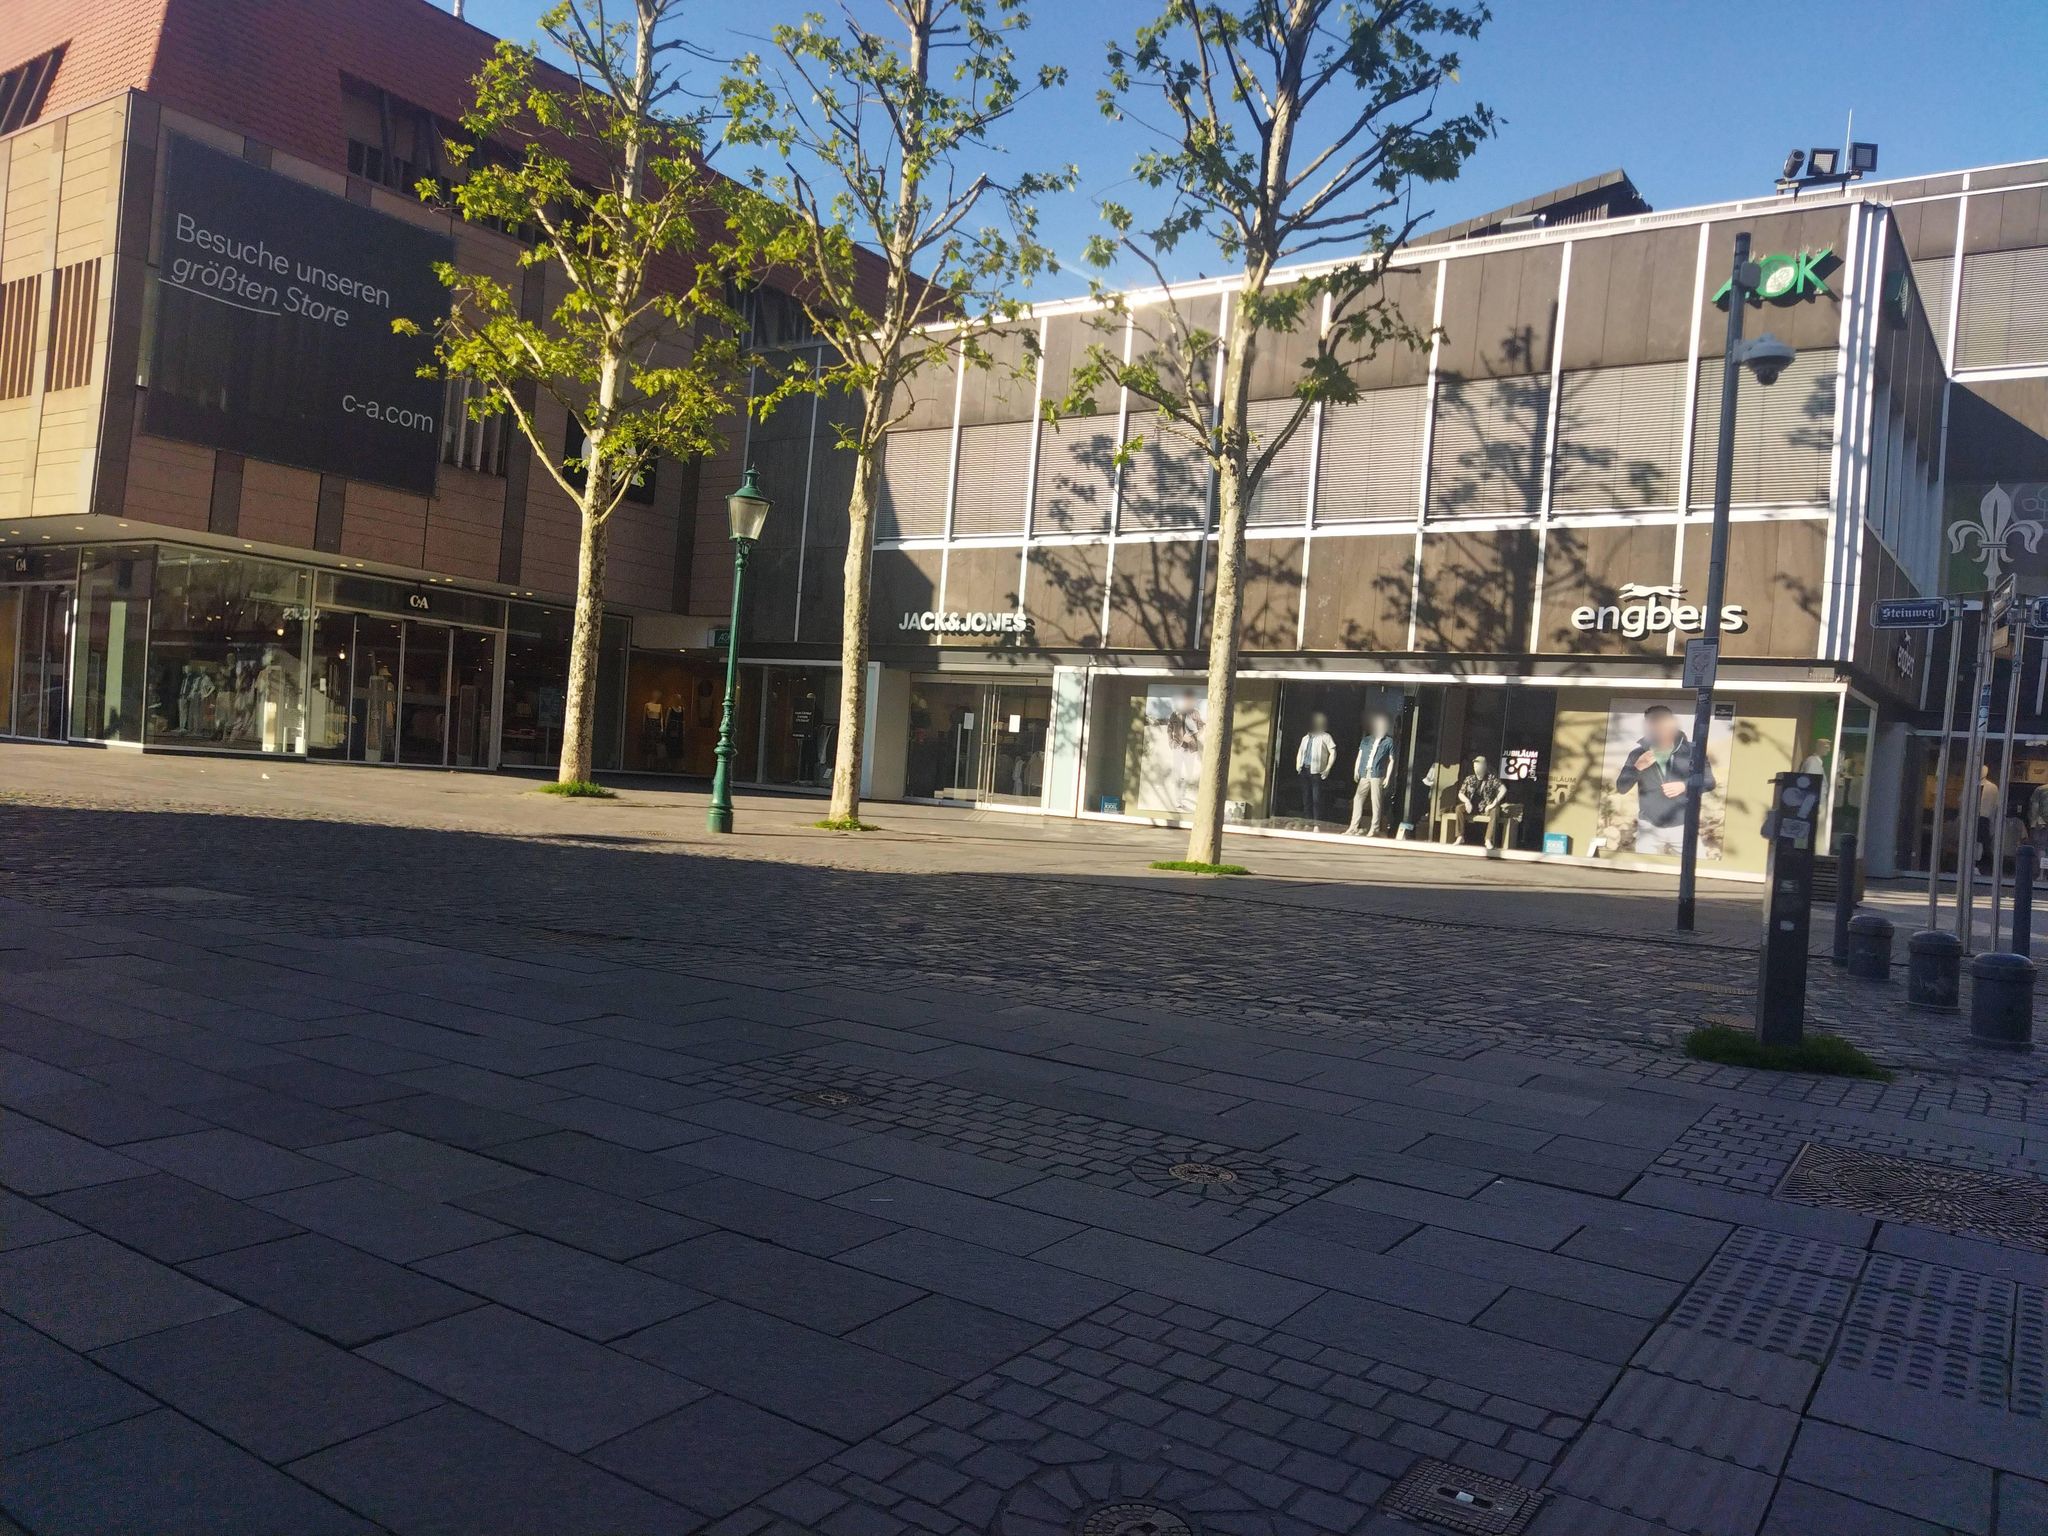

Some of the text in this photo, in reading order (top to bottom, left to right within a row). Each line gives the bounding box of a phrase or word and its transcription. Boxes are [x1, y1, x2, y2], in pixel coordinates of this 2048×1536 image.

[176, 212, 390, 308] Besuche unseren
[171, 257, 350, 327] größten Store
[342, 394, 433, 433] c-a.com
[899, 611, 1027, 632] JACK&JONES
[1881, 607, 1936, 620] Steinweg
[1502, 749, 1538, 758] JUBILÄUM
[1504, 757, 1529, 780] 80
